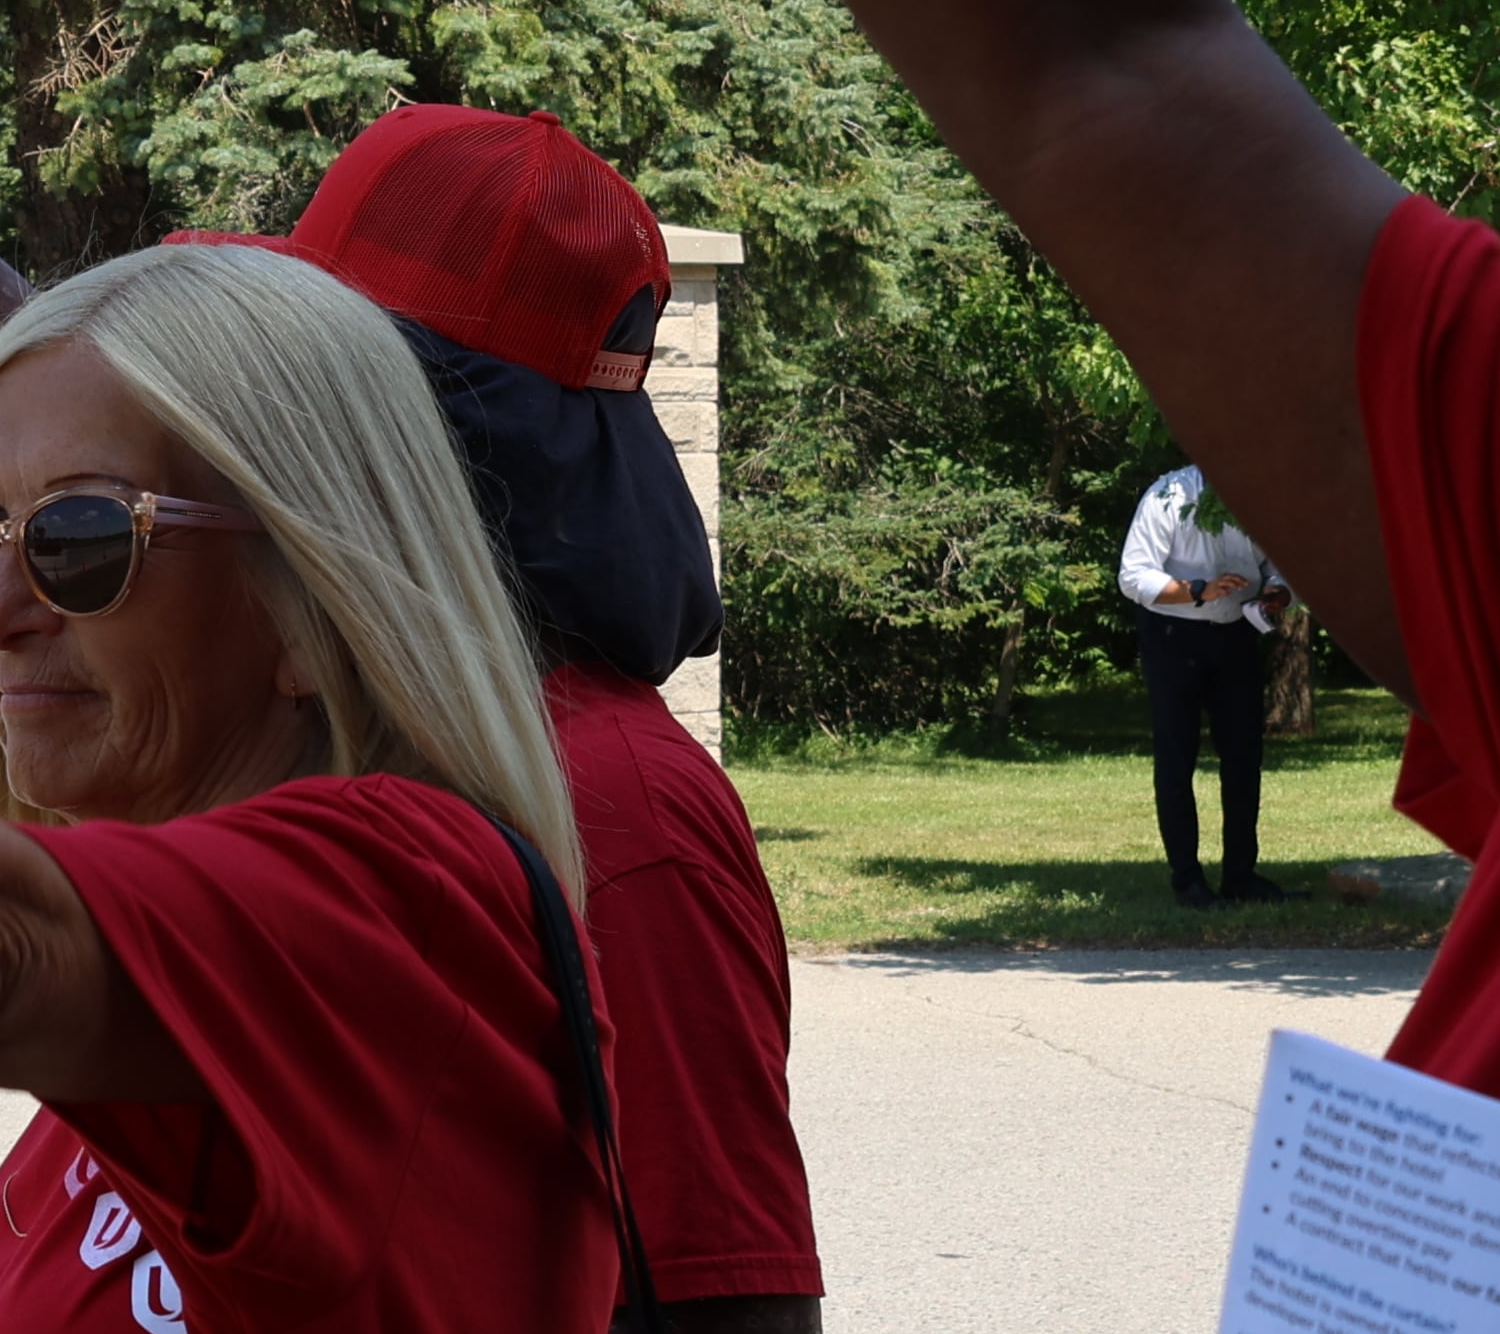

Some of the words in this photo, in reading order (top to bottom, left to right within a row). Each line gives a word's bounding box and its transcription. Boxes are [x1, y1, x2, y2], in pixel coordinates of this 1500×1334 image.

[1289, 1068, 1333, 1093] What
[1335, 1088, 1380, 1110] we're
[1384, 1101, 1448, 1137] fighting
[1308, 1099, 1323, 1114] A
[1325, 1104, 1353, 1125] fair
[1355, 1120, 1399, 1142] wage
[1402, 1133, 1438, 1154] that
[1299, 1144, 1363, 1177] Respect
[1365, 1168, 1390, 1187] for
[1392, 1181, 1423, 1199] our
[1424, 1194, 1467, 1215] work
[1303, 1122, 1344, 1150] bring
[1347, 1138, 1367, 1156] to
[1368, 1146, 1396, 1166] the
[1399, 1157, 1445, 1181] hotel
[1289, 1192, 1343, 1224] cutting
[1345, 1214, 1418, 1247] overtime
[1420, 1242, 1453, 1262] pay
[1293, 1166, 1317, 1184] An
[1319, 1179, 1352, 1198] end
[1352, 1189, 1371, 1207] to
[1373, 1200, 1466, 1239] concession
[1284, 1211, 1297, 1226] A
[1299, 1221, 1364, 1253] contract
[1366, 1244, 1401, 1266] that
[1403, 1257, 1448, 1284] helps
[1451, 1278, 1483, 1296] our
[1244, 1290, 1315, 1329] developer
[1250, 1265, 1275, 1289] The
[1277, 1281, 1316, 1306] hotel
[1318, 1299, 1333, 1314] is
[1300, 1266, 1355, 1298] behind
[1357, 1289, 1384, 1310] the
